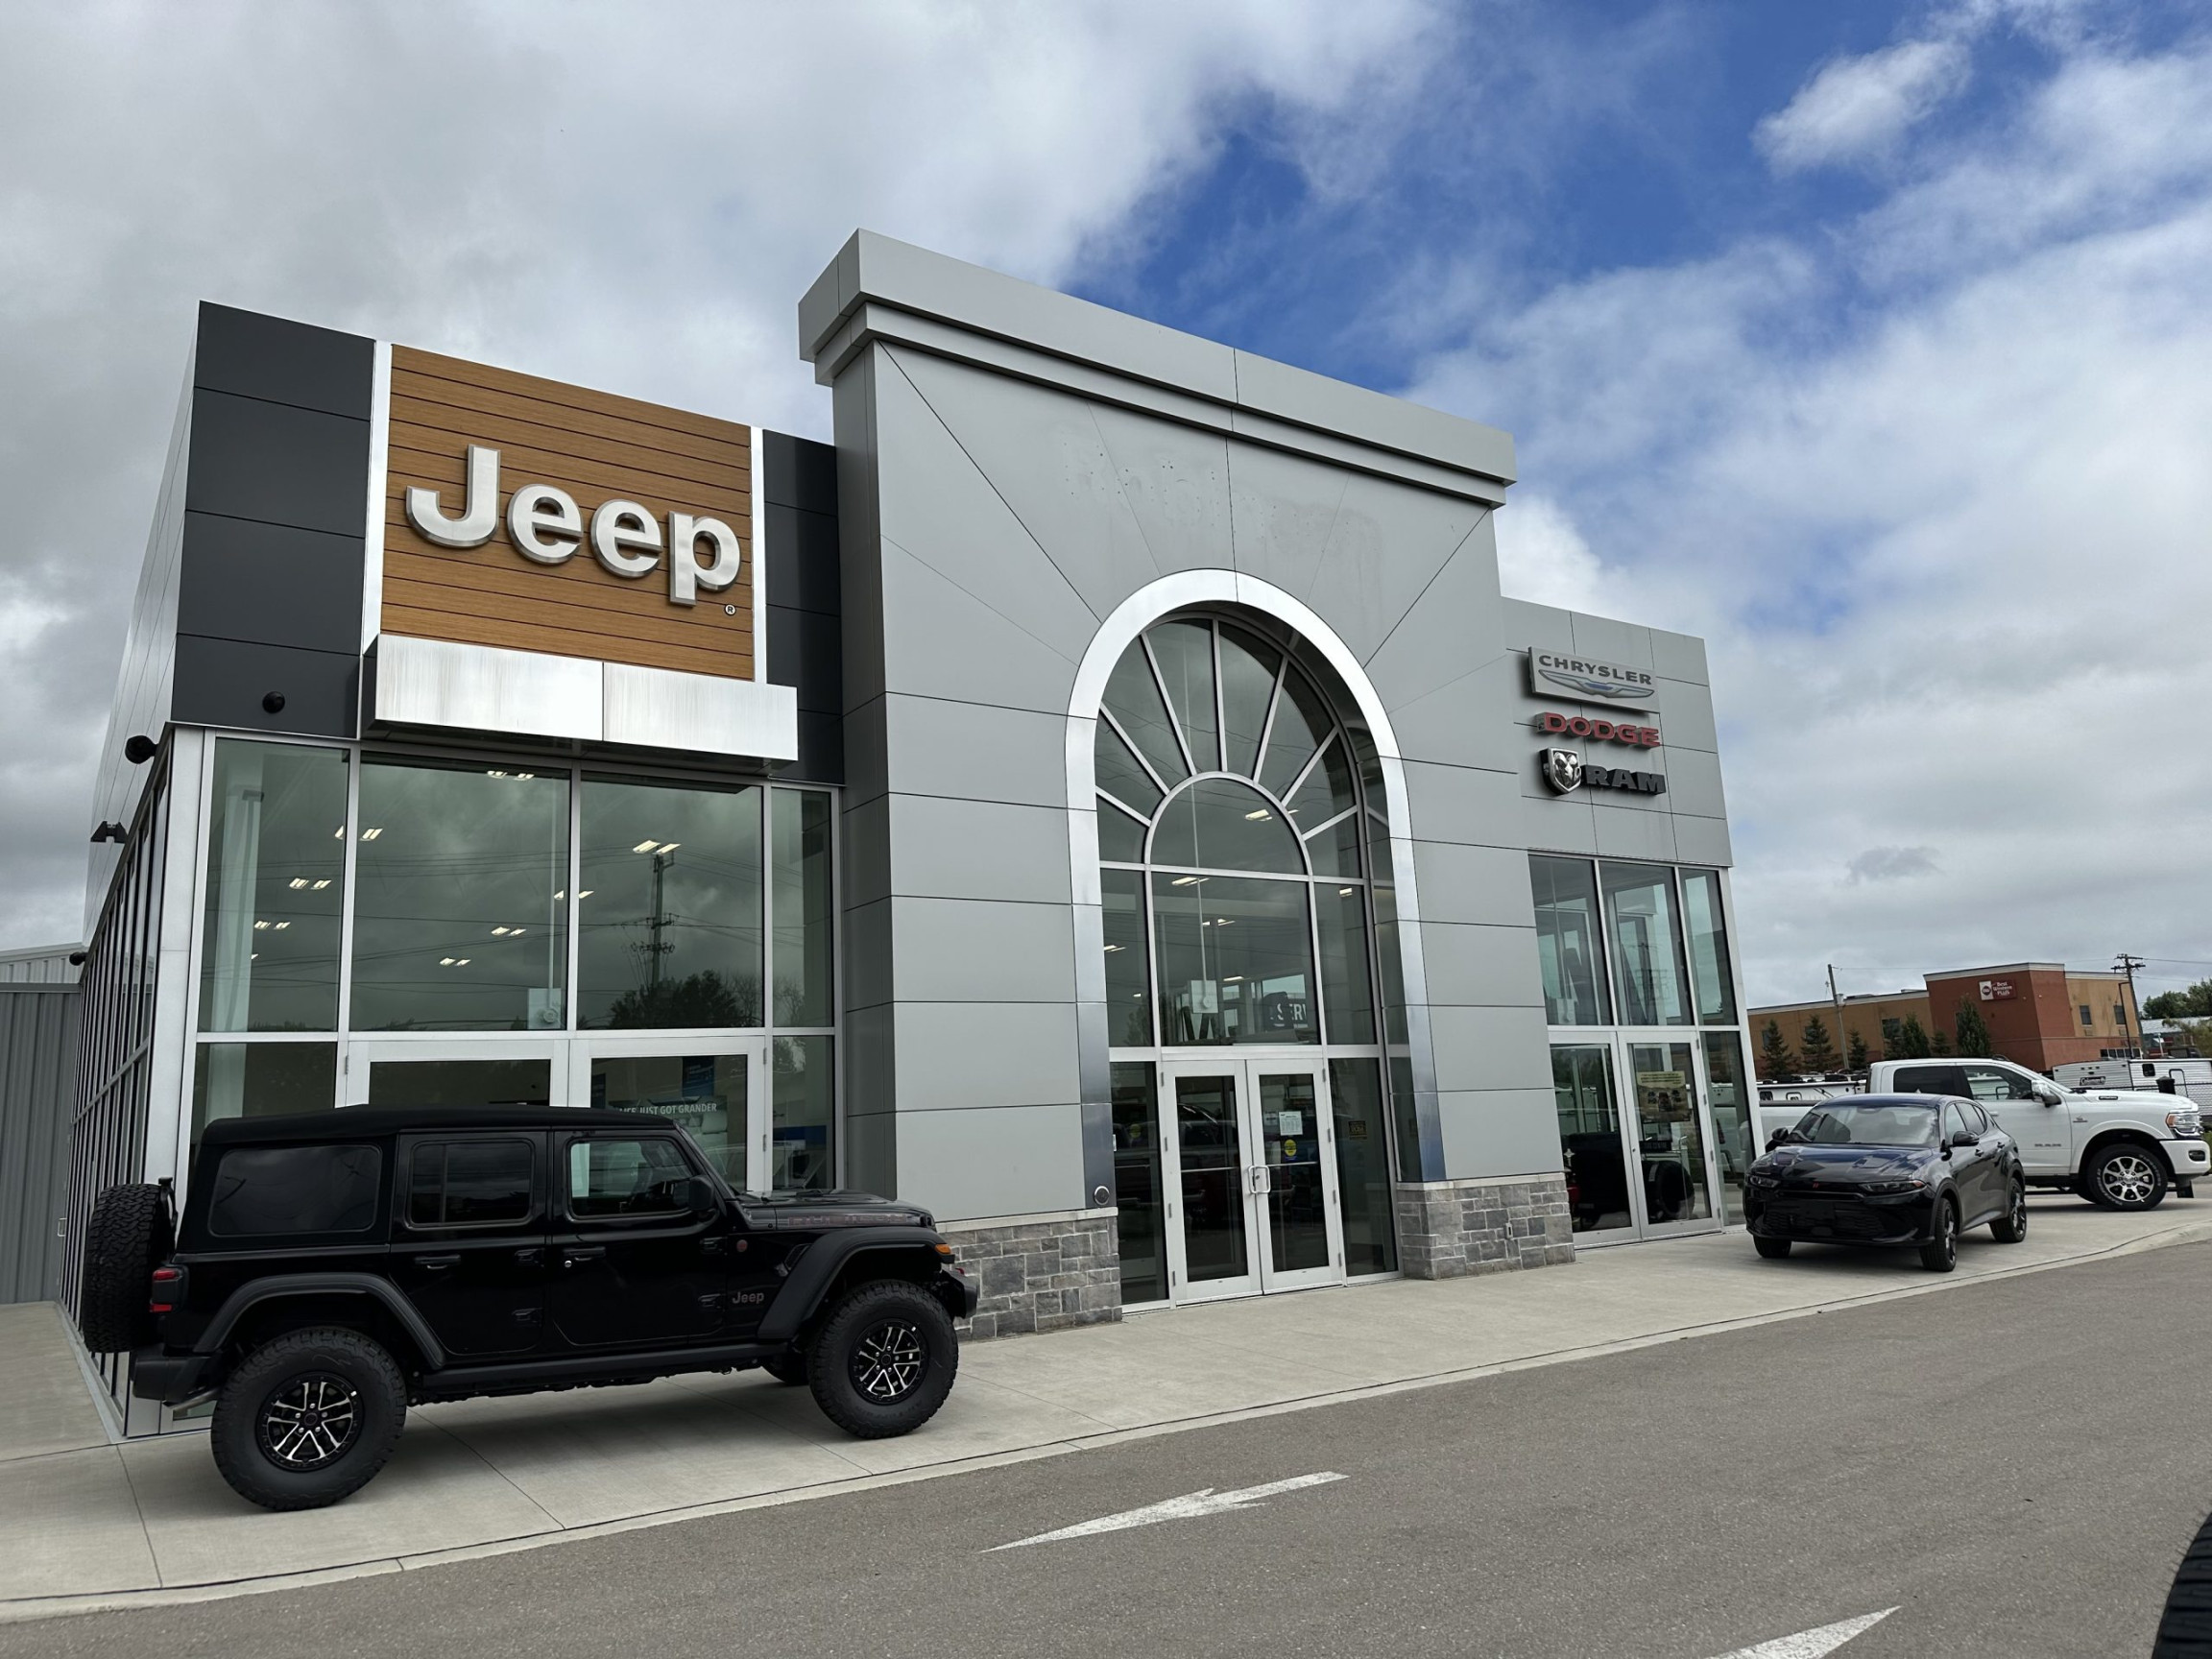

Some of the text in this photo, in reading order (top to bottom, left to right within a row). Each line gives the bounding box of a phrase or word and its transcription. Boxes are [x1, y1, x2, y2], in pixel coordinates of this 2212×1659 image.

[404, 444, 741, 607] Jeep
[1537, 654, 1653, 685] CHRYSLER
[1538, 711, 1661, 749] DODGE
[1582, 764, 1667, 794] RAM
[660, 1105, 677, 1115] GOT
[678, 1102, 718, 1114] GRANDER
[732, 1290, 766, 1305] Jeep
